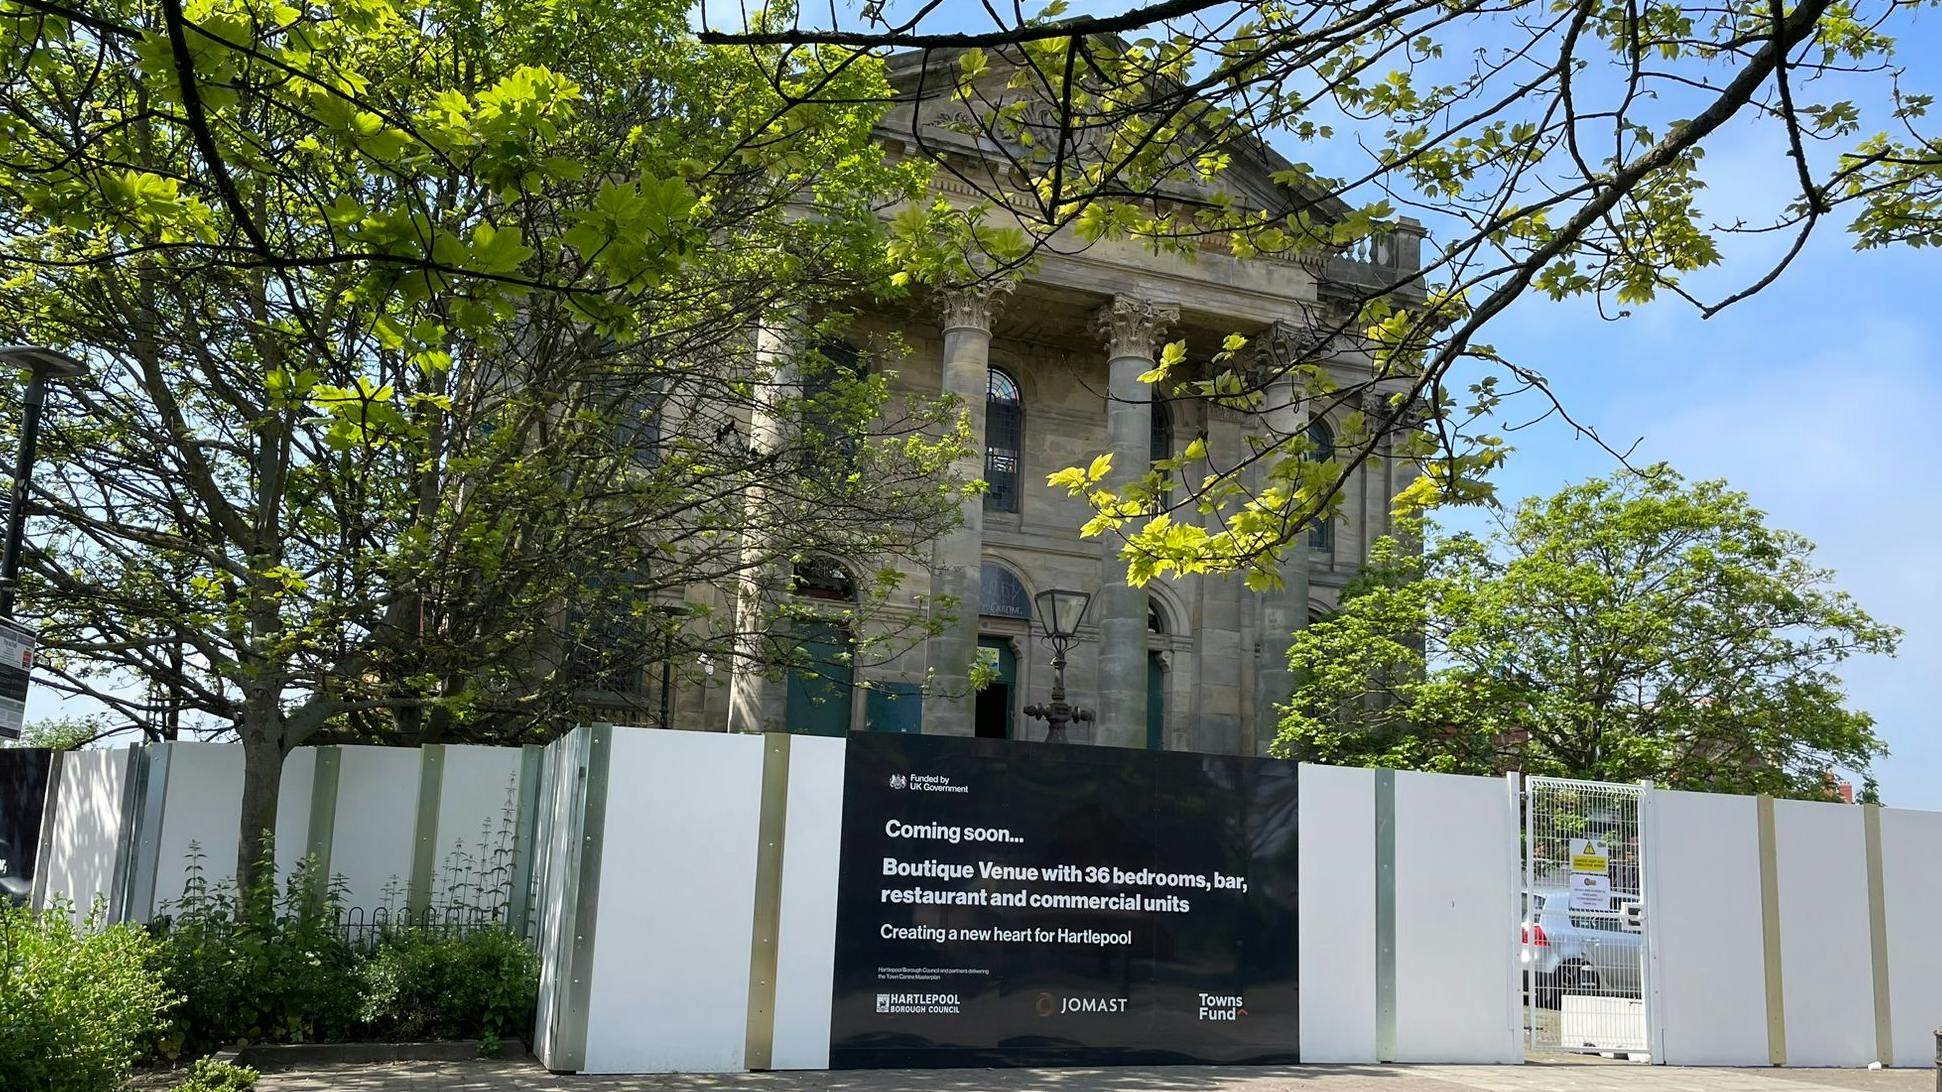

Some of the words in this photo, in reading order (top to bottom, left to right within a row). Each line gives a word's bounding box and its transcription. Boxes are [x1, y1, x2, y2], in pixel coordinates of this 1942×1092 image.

[910, 774, 939, 784] Funded
[940, 775, 950, 785] by
[910, 782, 922, 791] UK
[923, 783, 969, 793] Government
[885, 819, 961, 844] Coming
[963, 827, 1024, 843] soon...
[882, 857, 975, 882] Boutique
[978, 860, 1039, 881] Venue
[1041, 864, 1083, 883] with
[1084, 866, 1111, 884] 36
[1112, 866, 1212, 892] bedrooms,
[1213, 871, 1248, 894] bar,
[881, 886, 988, 906] restaurant
[989, 890, 1027, 907] and
[1029, 892, 1142, 911] commercial
[1143, 894, 1190, 913] units
[880, 923, 946, 943] Creating
[947, 928, 958, 941] a
[960, 929, 992, 941] new
[993, 926, 1033, 943] heart
[1034, 928, 1056, 943] for
[1057, 928, 1132, 947] Hartlepool
[890, 993, 961, 1005] HARTLEPOOL
[1060, 997, 1128, 1014] JOMAST
[1198, 992, 1243, 1007] Towns
[890, 1005, 926, 1013] BOROUGH
[928, 1005, 960, 1014] COUNCIL
[1198, 1007, 1236, 1021] Fund
